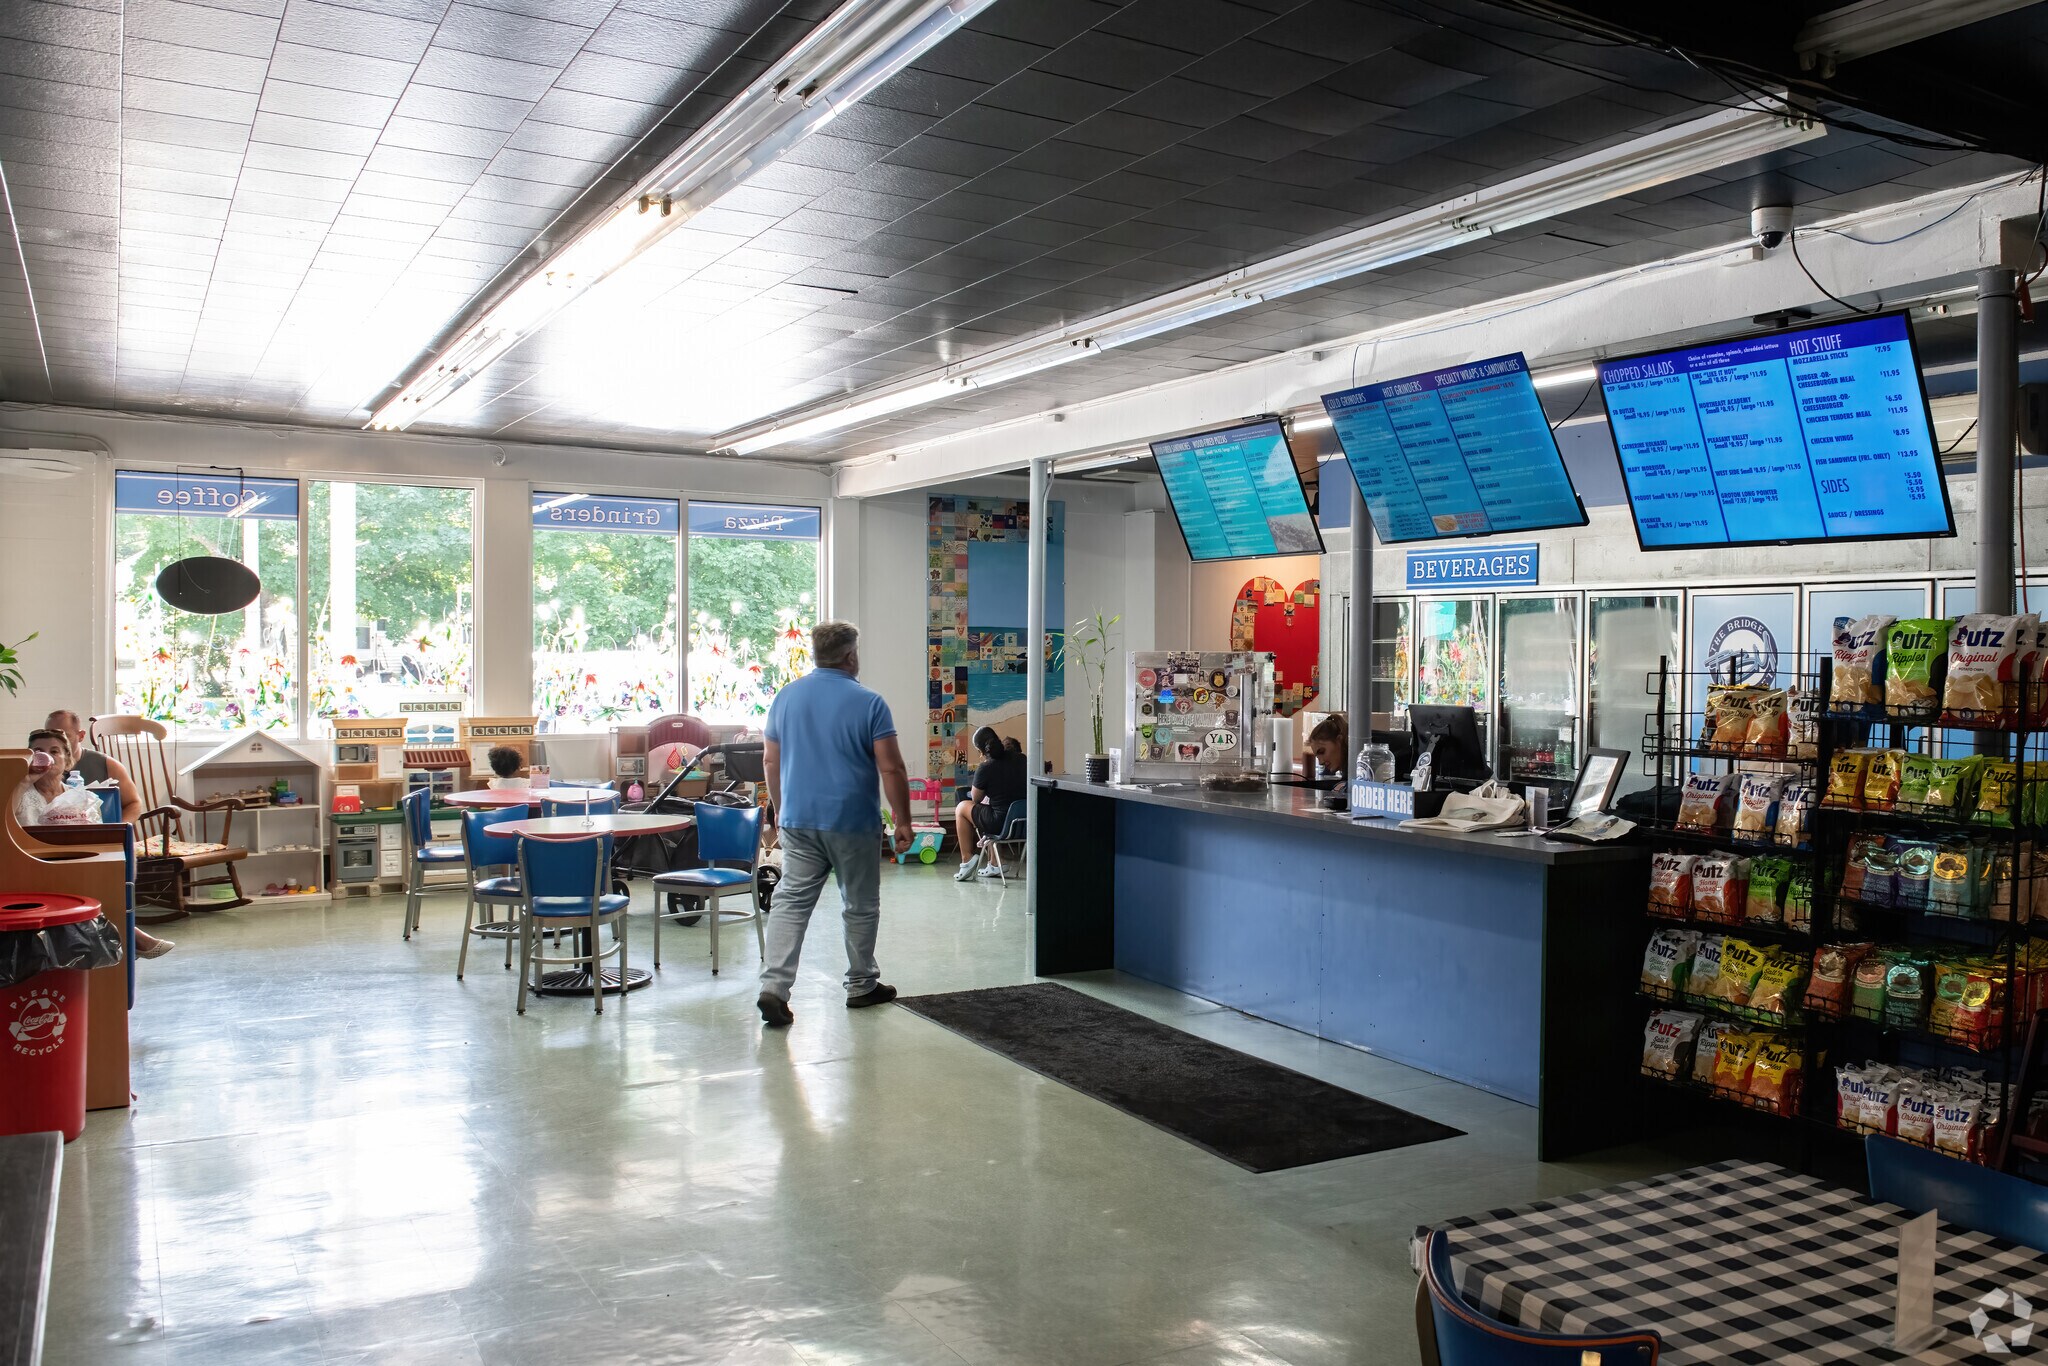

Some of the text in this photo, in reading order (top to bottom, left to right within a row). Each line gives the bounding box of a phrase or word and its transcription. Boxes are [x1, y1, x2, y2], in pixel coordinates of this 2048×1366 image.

[1744, 344, 1763, 353] shredded
[1789, 333, 1842, 356] HOT STUFF
[1874, 344, 1891, 353] $7.95
[1793, 351, 1849, 365] MOZZARELLA STICKS
[1434, 371, 1461, 387] SPECIALTY
[1461, 367, 1479, 381] WRAPS
[1484, 358, 1520, 377] SANDWICHES
[1603, 360, 1675, 384] CHOPPED SALADS
[1796, 371, 1832, 381] BURGER -OR-
[1880, 368, 1900, 378] $11.95
[1699, 377, 1713, 385] Small
[1733, 373, 1749, 381] Large
[1797, 375, 1856, 389] CHEESEBURGER MEAL
[1381, 380, 1423, 398] HOT GRINDERS
[1327, 392, 1367, 410] COLD GRINDERS
[1699, 396, 1751, 409] NORTHEAST ACADEMY
[1801, 397, 1814, 405] JUST
[1815, 394, 1837, 403] BURGER
[1885, 393, 1903, 402] $6.50
[1705, 406, 1720, 414] Small
[1740, 402, 1756, 411] Large
[1803, 401, 1844, 412] CHEESEBURGER
[1887, 405, 1908, 414] $11.95
[1805, 410, 1872, 424] CHICKEN TENDERS MEAL
[1892, 428, 1910, 436] $8.95
[1707, 433, 1749, 444] PLEASANT VALLEY
[1810, 434, 1854, 445] CHICKEN WINGS
[1714, 441, 1729, 449] Small
[1815, 452, 1891, 466] FISH SANDWICH (FRI. ONLY)
[1897, 449, 1919, 458] $13.95
[1729, 468, 1740, 476] SIDE
[1740, 467, 1753, 475] Small
[1904, 471, 1921, 479] $5.50
[1820, 478, 1850, 494] SIDES
[1854, 508, 1884, 517] DRESSINGS
[1413, 554, 1530, 579] BEVERAGES
[1710, 618, 1764, 653] THE BRIDGE
[1891, 652, 1926, 665] Ripples
[1950, 651, 1999, 668] Original
[1351, 784, 1413, 815] ORDER HERE
[1685, 791, 1715, 801] Original
[1699, 880, 1719, 888] Honey
[9, 988, 66, 1010] PLEASE
[1653, 1036, 1665, 1044] Salt
[12, 1036, 65, 1056] RECYCLE
[1650, 1042, 1669, 1051] Pepper
[1936, 1121, 1968, 1132] Original
